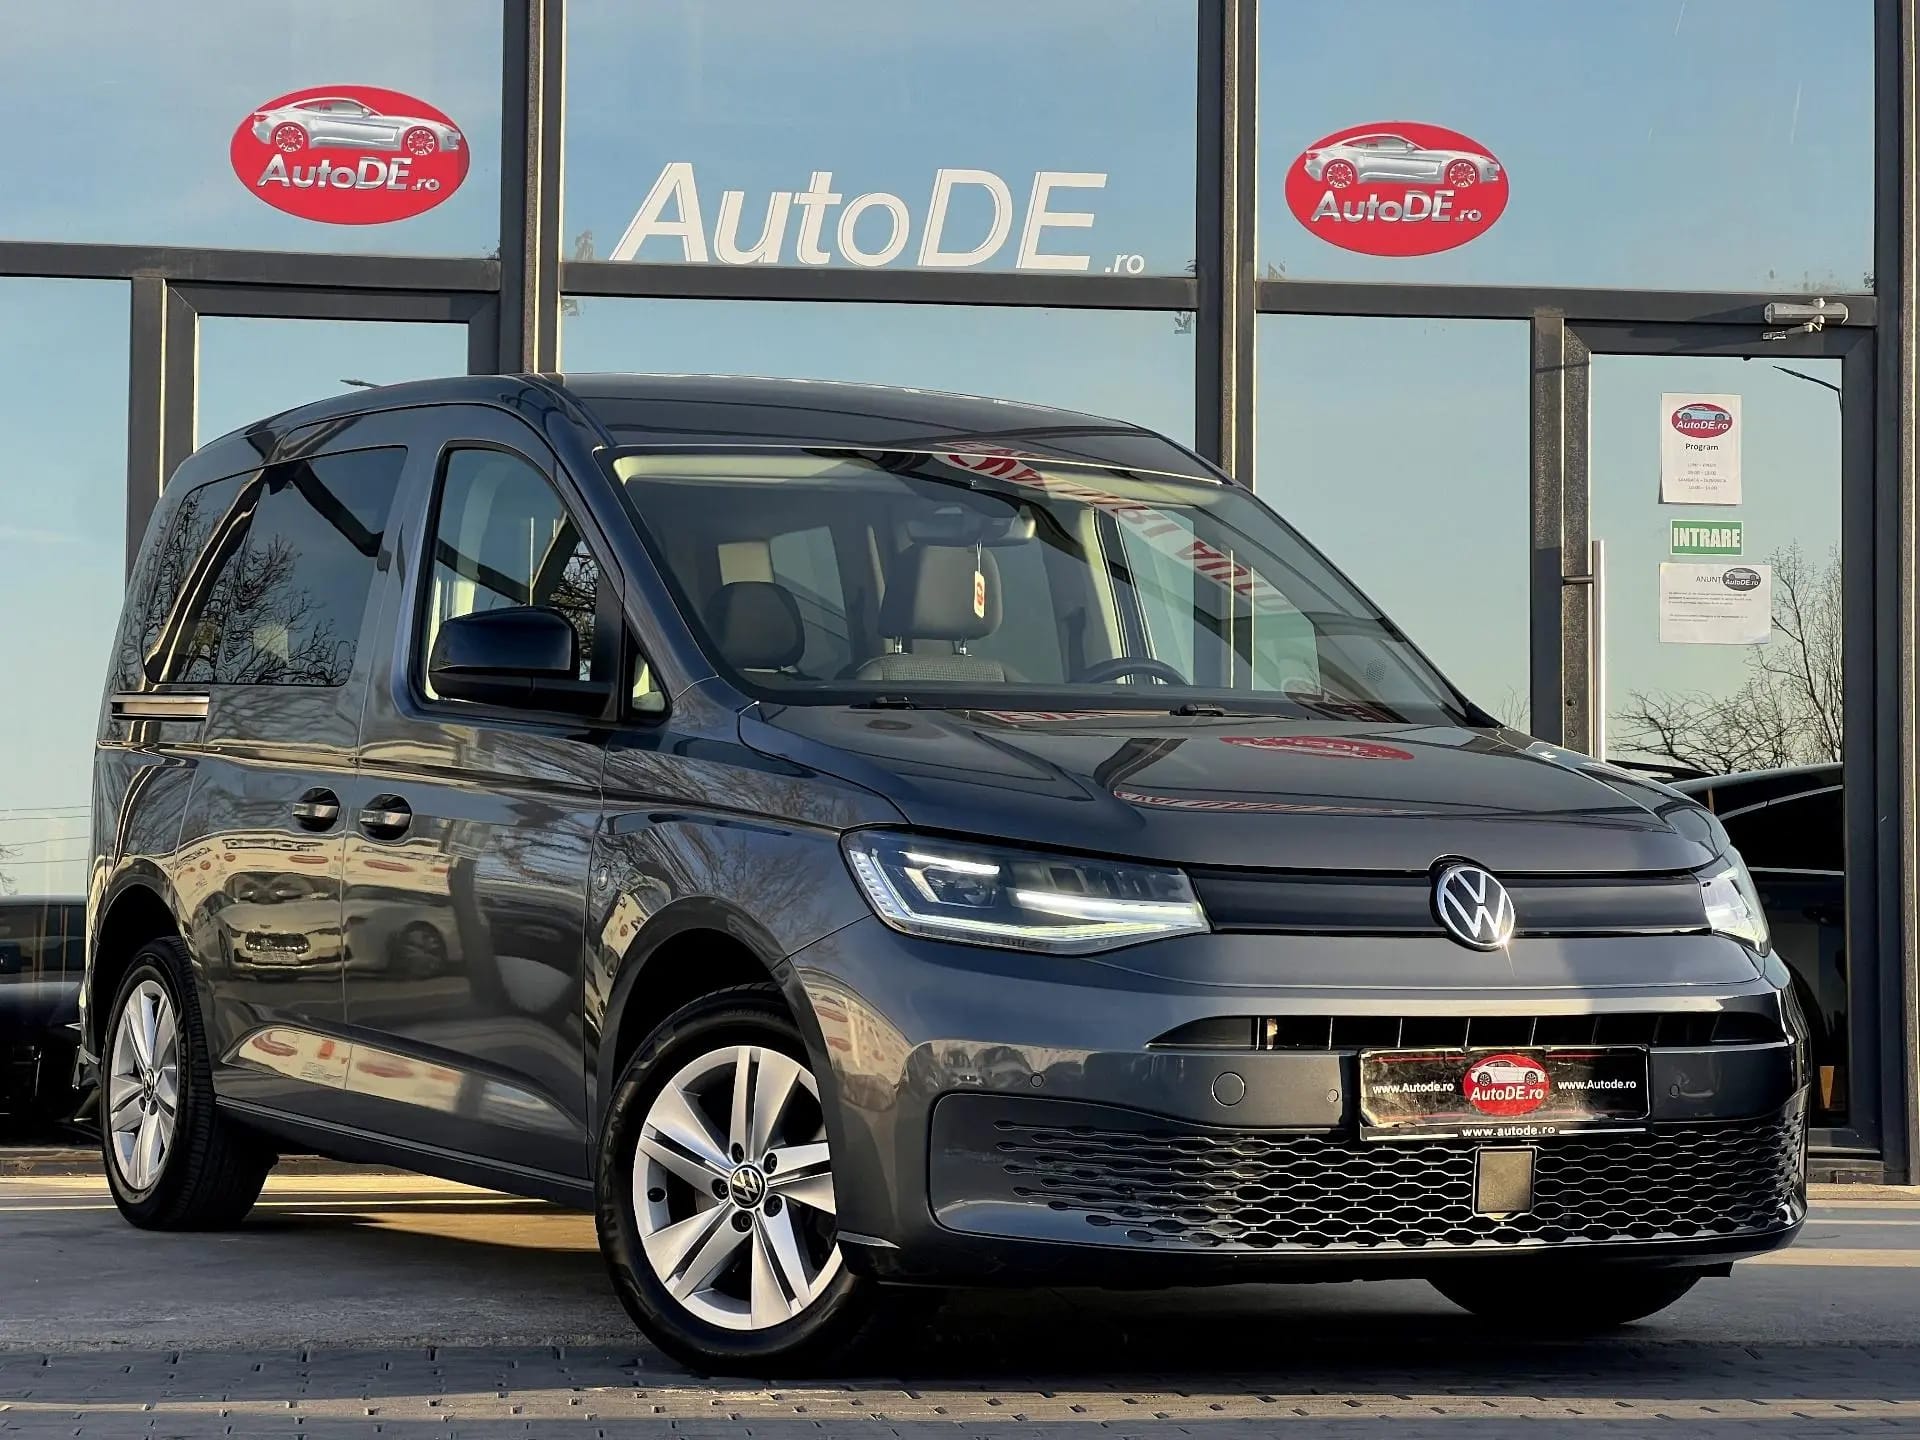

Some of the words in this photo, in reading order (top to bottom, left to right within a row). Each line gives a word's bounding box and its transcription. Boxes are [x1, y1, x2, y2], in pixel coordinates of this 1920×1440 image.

[1676, 420, 1729, 430] AutoDE.ro
[1685, 443, 1719, 451] Program
[1673, 527, 1741, 548] INTRARE
[1372, 1081, 1454, 1094] www.Autode.ro
[1557, 1079, 1637, 1090] www.Autode.ro
[1470, 1086, 1544, 1101] AutoDE.ro
[1462, 1125, 1556, 1137] www.autode.ro
